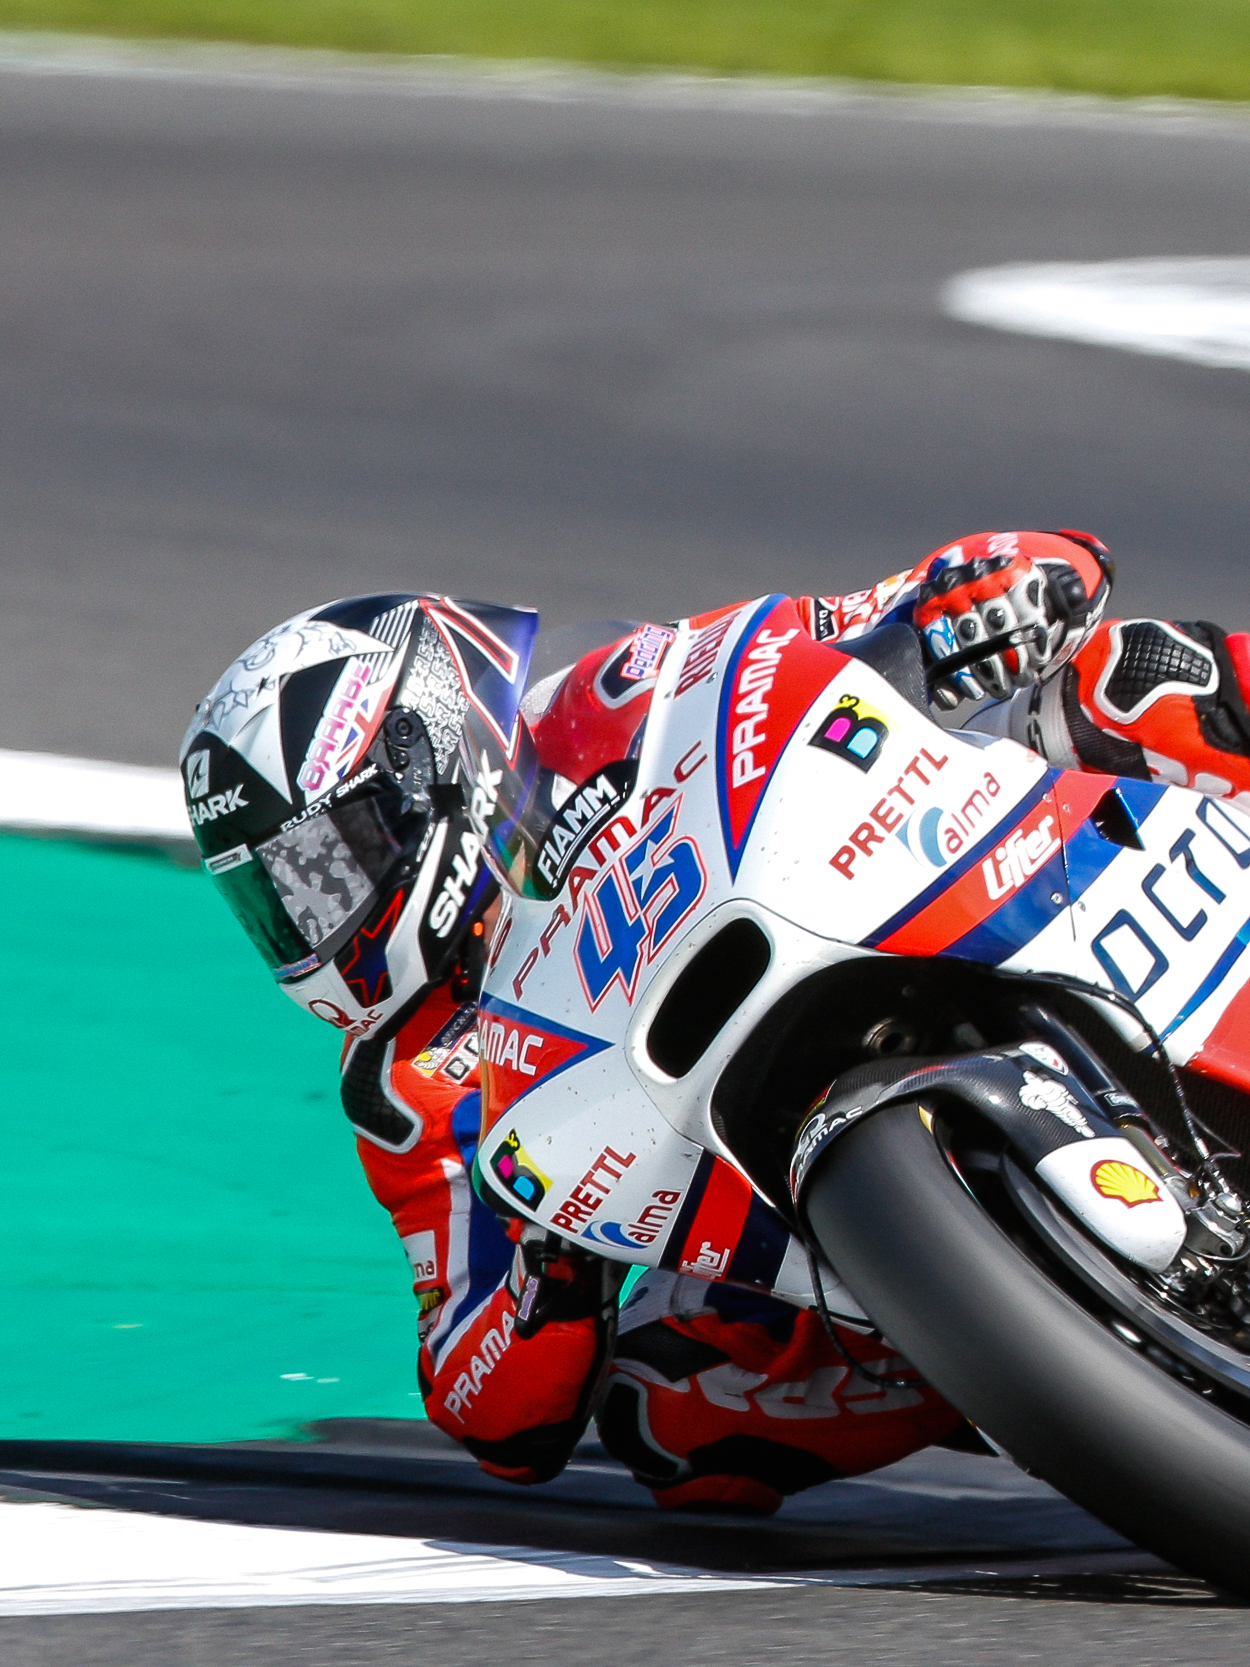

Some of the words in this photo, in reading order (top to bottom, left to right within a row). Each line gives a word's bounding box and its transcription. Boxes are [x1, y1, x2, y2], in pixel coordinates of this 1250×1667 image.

[732, 628, 800, 788] PRAMAC
[190, 784, 249, 826] HARK
[280, 796, 332, 834] RUDY
[336, 763, 380, 797] SHARK
[536, 774, 618, 884] FIAMM
[829, 748, 948, 879] PRETTL
[943, 771, 1000, 855] alma
[429, 748, 504, 939] SHARK
[982, 815, 1063, 900] Lifter
[574, 793, 708, 1013] 45
[479, 1013, 545, 1076] AMAC
[549, 1145, 637, 1234] PRETTL
[628, 1189, 682, 1244] alma
[444, 1310, 516, 1424] PRAMA
